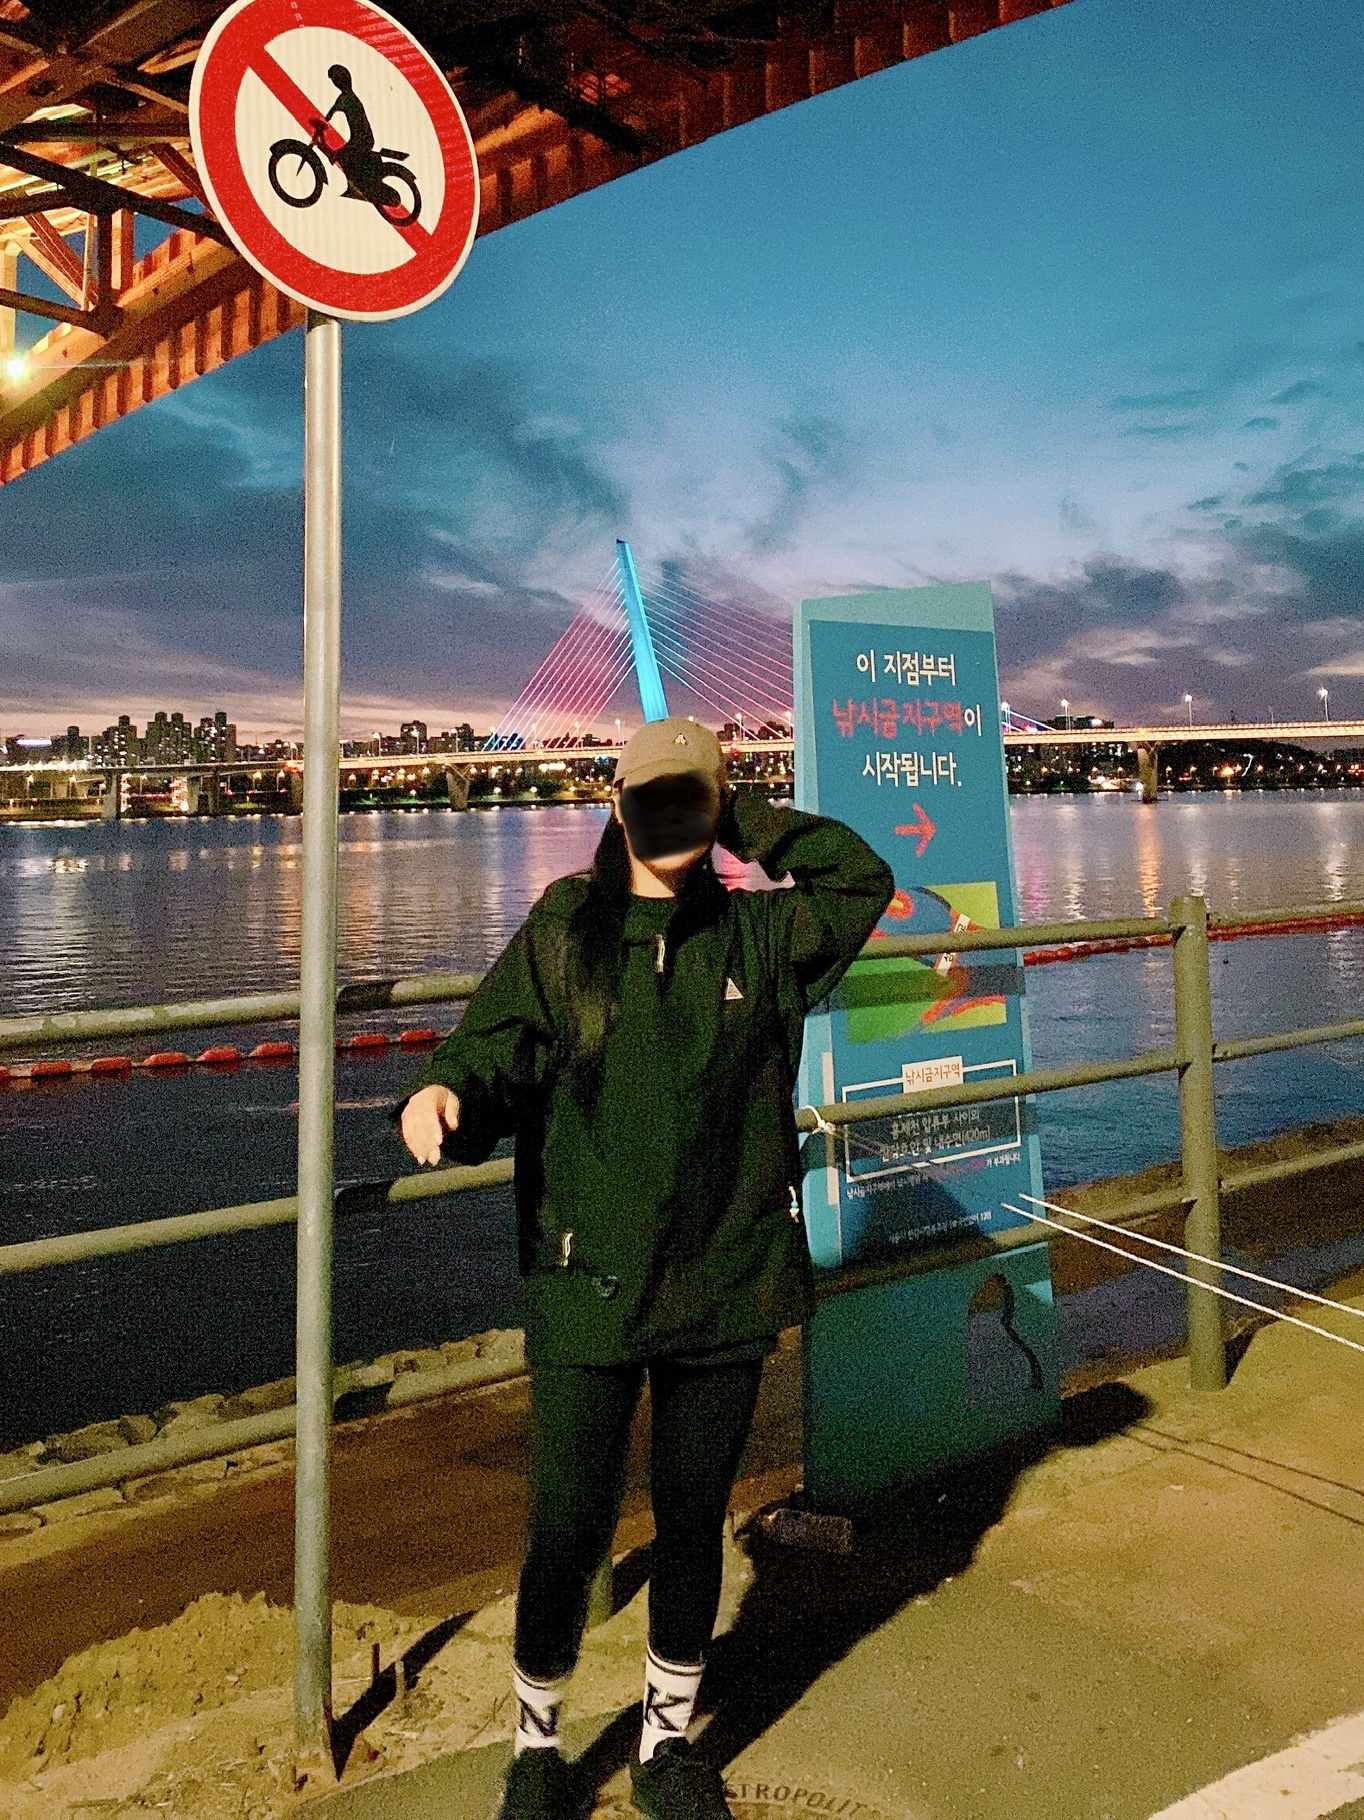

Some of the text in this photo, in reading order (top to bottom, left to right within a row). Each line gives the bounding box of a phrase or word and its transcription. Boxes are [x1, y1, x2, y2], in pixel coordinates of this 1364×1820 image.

[856, 649, 956, 686] 이 지점부터
[861, 751, 962, 787] 시작됩니다.
[905, 1063, 961, 1086] 낚시금지구역
